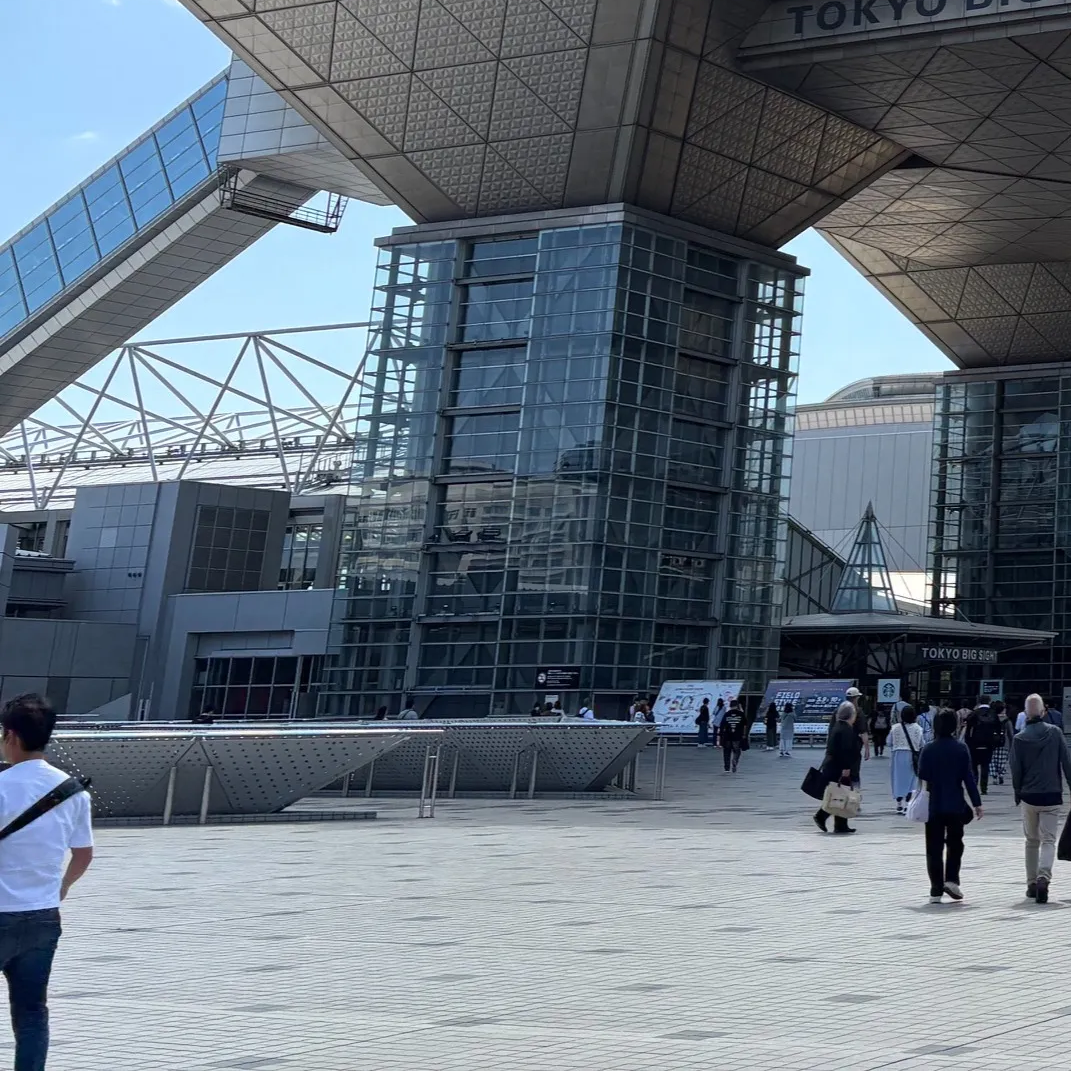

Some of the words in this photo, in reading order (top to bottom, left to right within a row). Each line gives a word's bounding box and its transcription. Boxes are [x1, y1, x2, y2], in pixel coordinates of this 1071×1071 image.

[921, 647, 960, 659] TOKYO
[962, 649, 977, 660] BIG
[978, 650, 998, 661] SIGHT
[775, 691, 801, 699] FIELD
